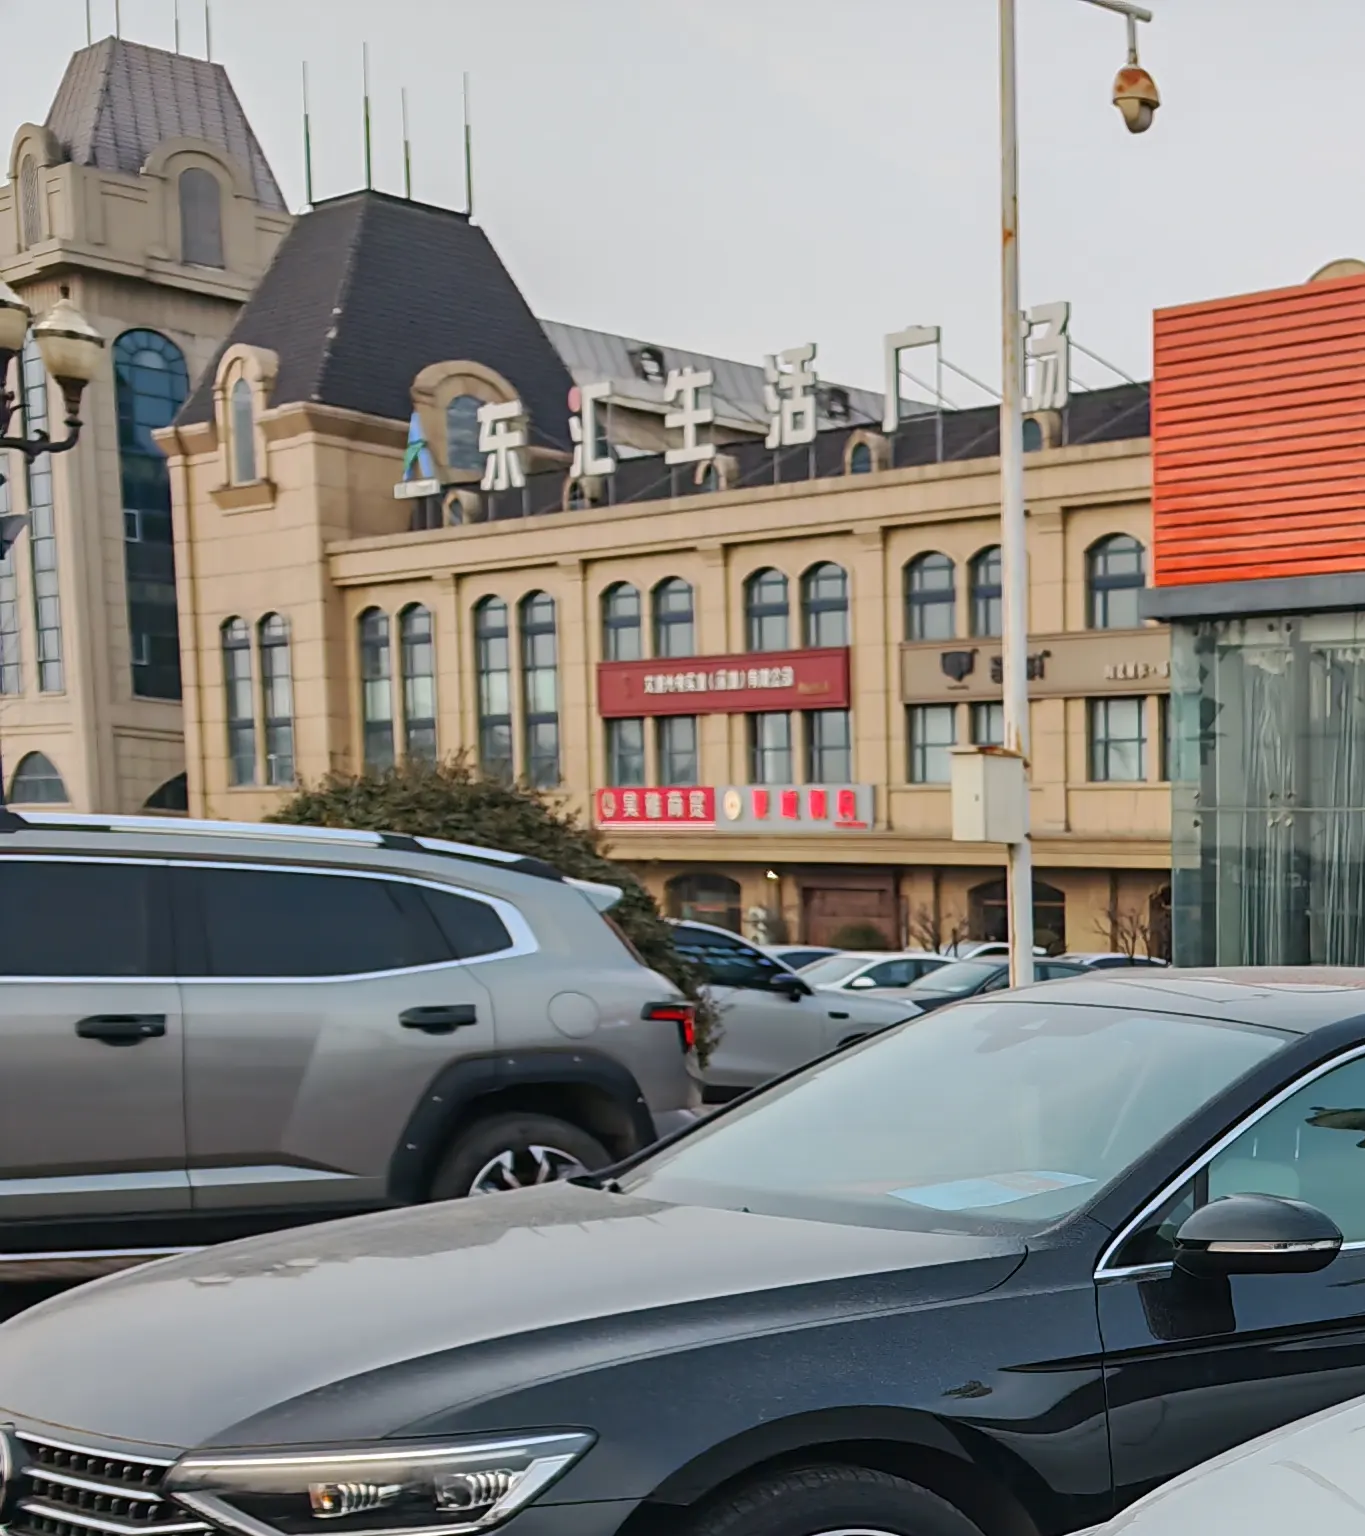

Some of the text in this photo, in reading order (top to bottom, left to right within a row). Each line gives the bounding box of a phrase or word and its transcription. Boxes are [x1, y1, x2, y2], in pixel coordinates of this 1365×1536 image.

[477, 301, 1071, 492] 东汇生活广场
